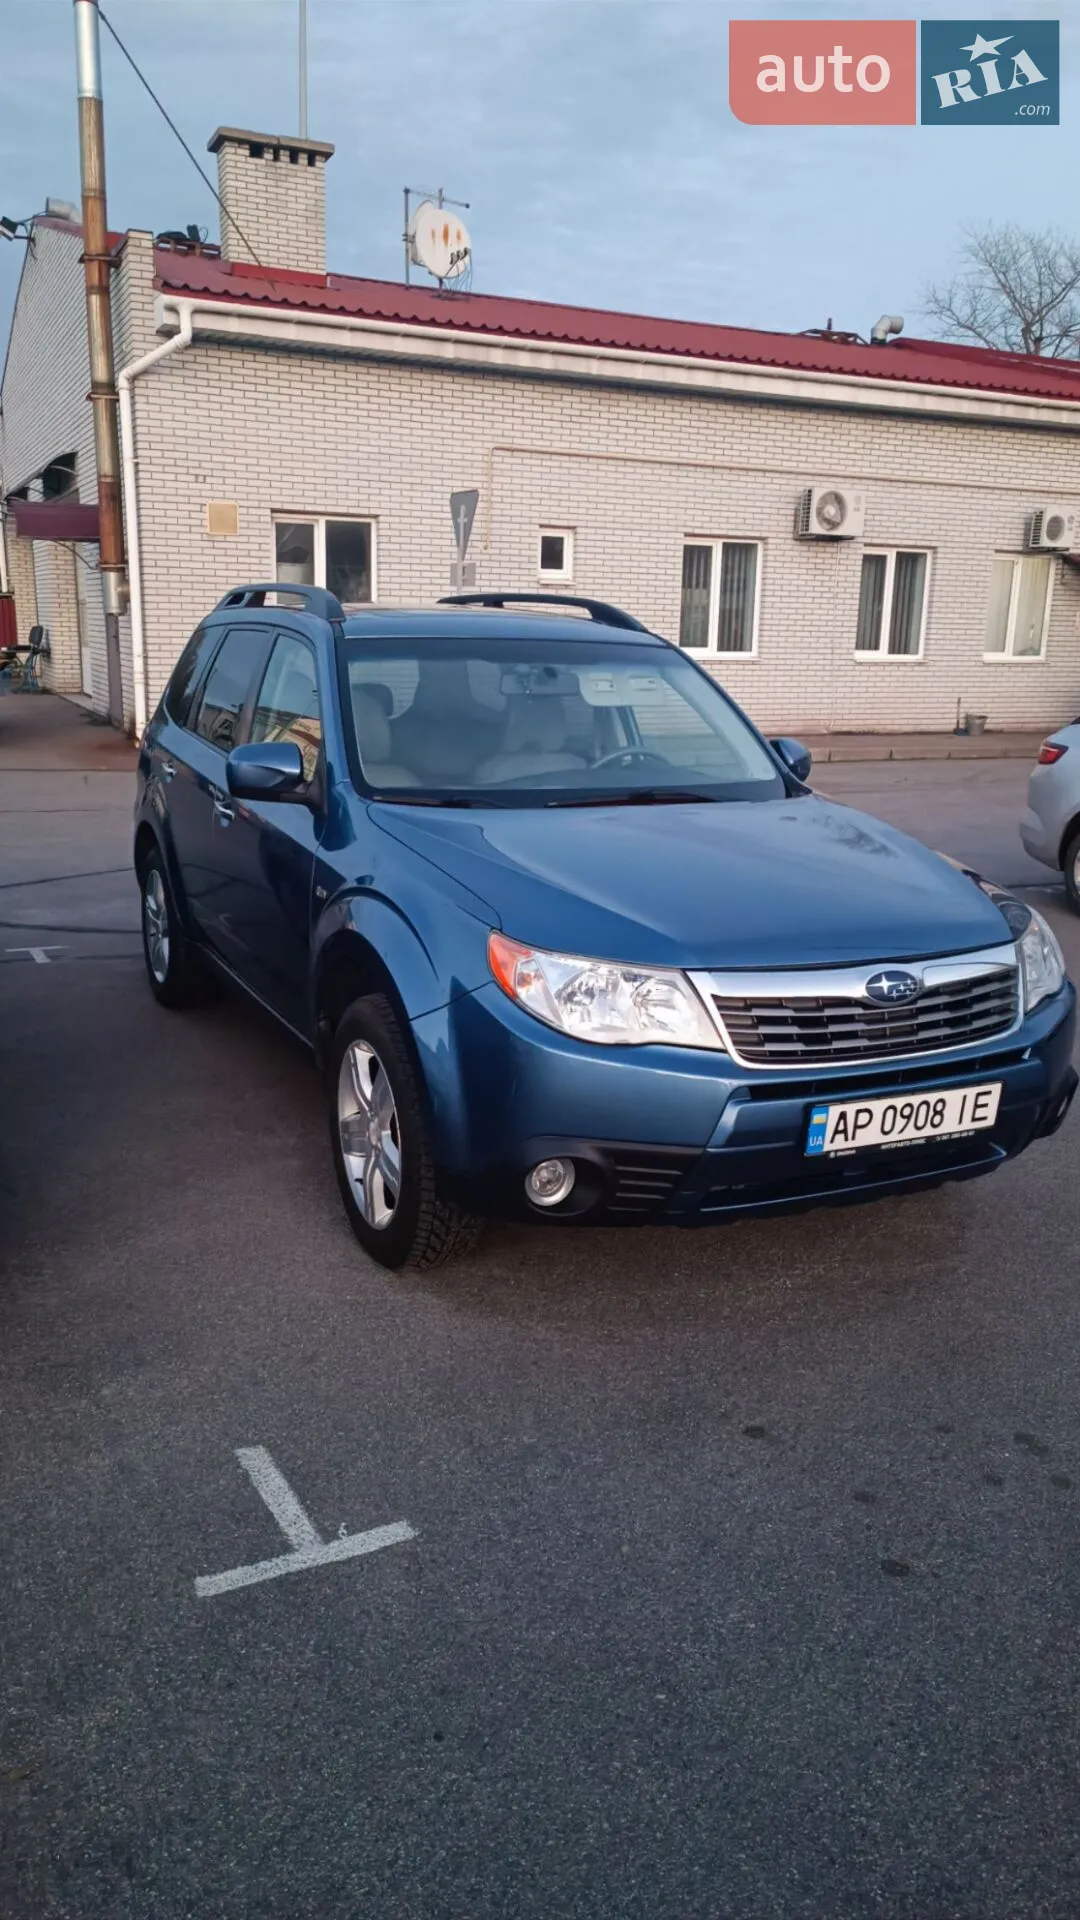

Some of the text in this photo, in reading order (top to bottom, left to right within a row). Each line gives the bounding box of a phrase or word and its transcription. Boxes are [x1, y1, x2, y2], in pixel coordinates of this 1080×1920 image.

[829, 1090, 992, 1144] AP 0908 IE
[809, 1135, 824, 1147] UA
